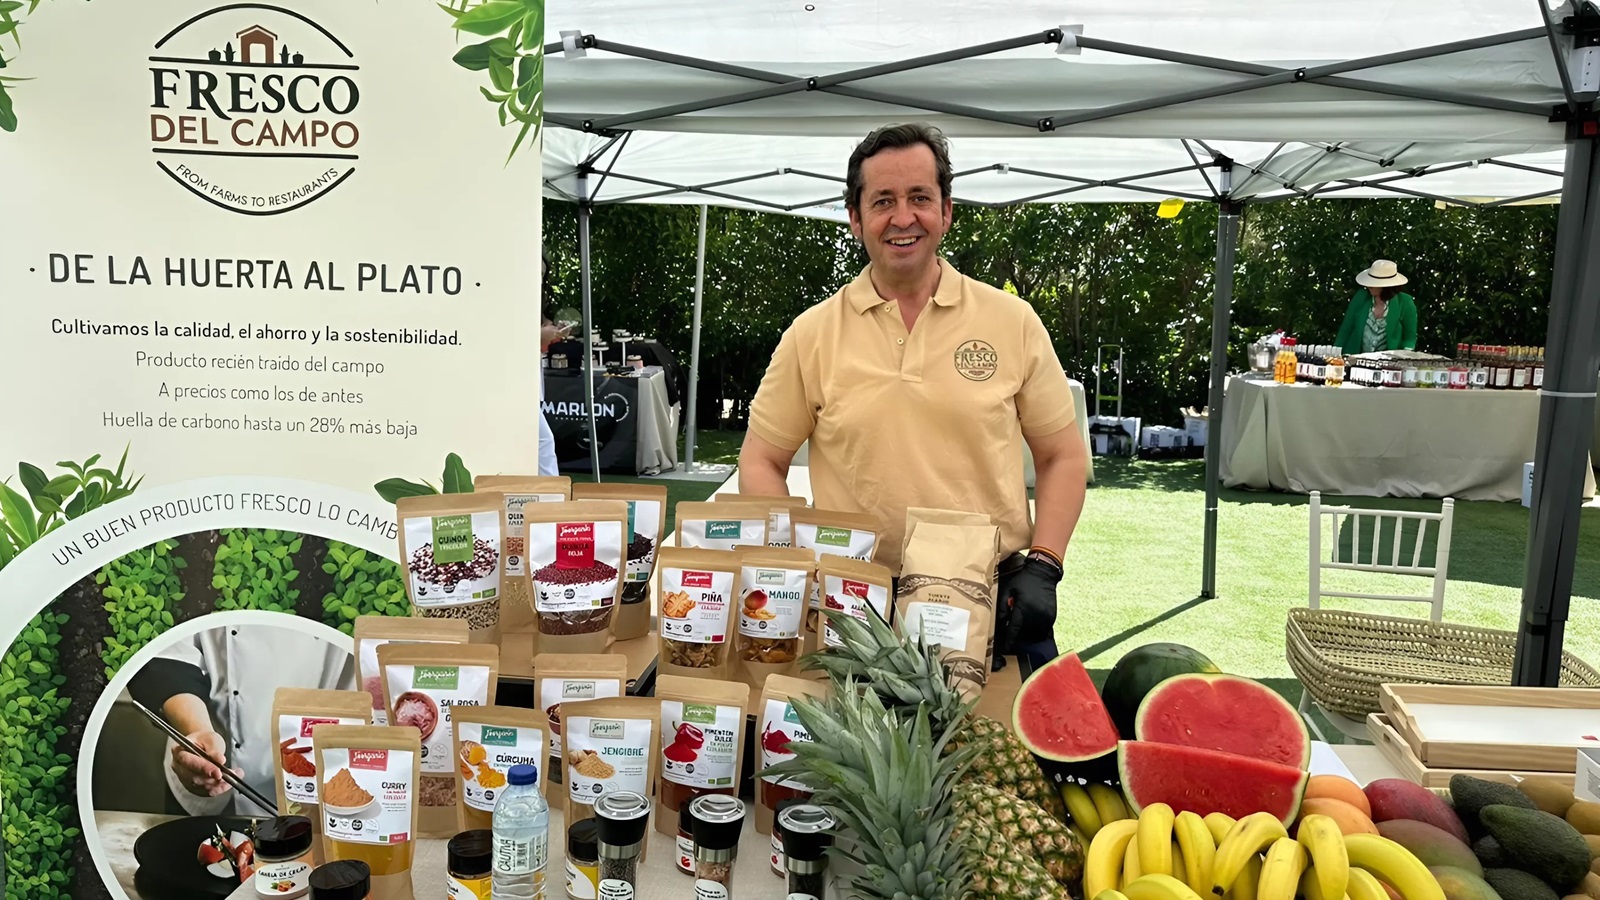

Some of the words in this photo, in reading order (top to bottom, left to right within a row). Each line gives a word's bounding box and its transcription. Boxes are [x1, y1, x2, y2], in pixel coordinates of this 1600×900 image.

[148, 66, 360, 121] FRESCO
[150, 113, 219, 145] DEL
[230, 118, 360, 149] CAMPO
[175, 163, 210, 191] FROM
[209, 184, 249, 206] FARMS
[251, 195, 266, 208] TO
[268, 167, 340, 207] RESTAURANTS
[48, 252, 96, 284] DE
[107, 255, 152, 286] LA
[164, 256, 294, 290] HUERTA
[303, 260, 346, 292] AL
[357, 262, 463, 296] PLATO
[51, 318, 150, 337] Cultivamos
[154, 320, 169, 337] la
[173, 321, 235, 340] calidad,
[238, 322, 252, 339] el
[255, 323, 307, 341] ahorro
[310, 329, 321, 346] y
[325, 324, 340, 342] la
[344, 327, 463, 346] sostenibilidad.
[136, 350, 207, 369] Producto
[211, 353, 255, 370] recién
[304, 355, 327, 372] del
[331, 361, 385, 378] campo
[158, 381, 170, 398] A
[174, 383, 227, 402] precios
[230, 387, 270, 402] como
[274, 385, 295, 402] los
[298, 386, 317, 403] de
[321, 388, 364, 404] antes
[541, 400, 615, 418] MARLON
[102, 411, 154, 428] Huella
[158, 411, 178, 428] de
[181, 412, 240, 431] carbono
[243, 414, 282, 432] hasta
[286, 420, 305, 432] un
[309, 416, 345, 434] 28%
[349, 417, 382, 435] más
[386, 418, 418, 440] baja
[51, 540, 84, 567] UN
[82, 514, 137, 550] BUEN
[139, 493, 235, 526] PRODUCTO
[240, 492, 312, 516] FRESCO
[317, 501, 341, 521] LO
[345, 508, 398, 540] CAMB
[701, 591, 723, 603] PIÑA
[768, 590, 800, 600] MANGO
